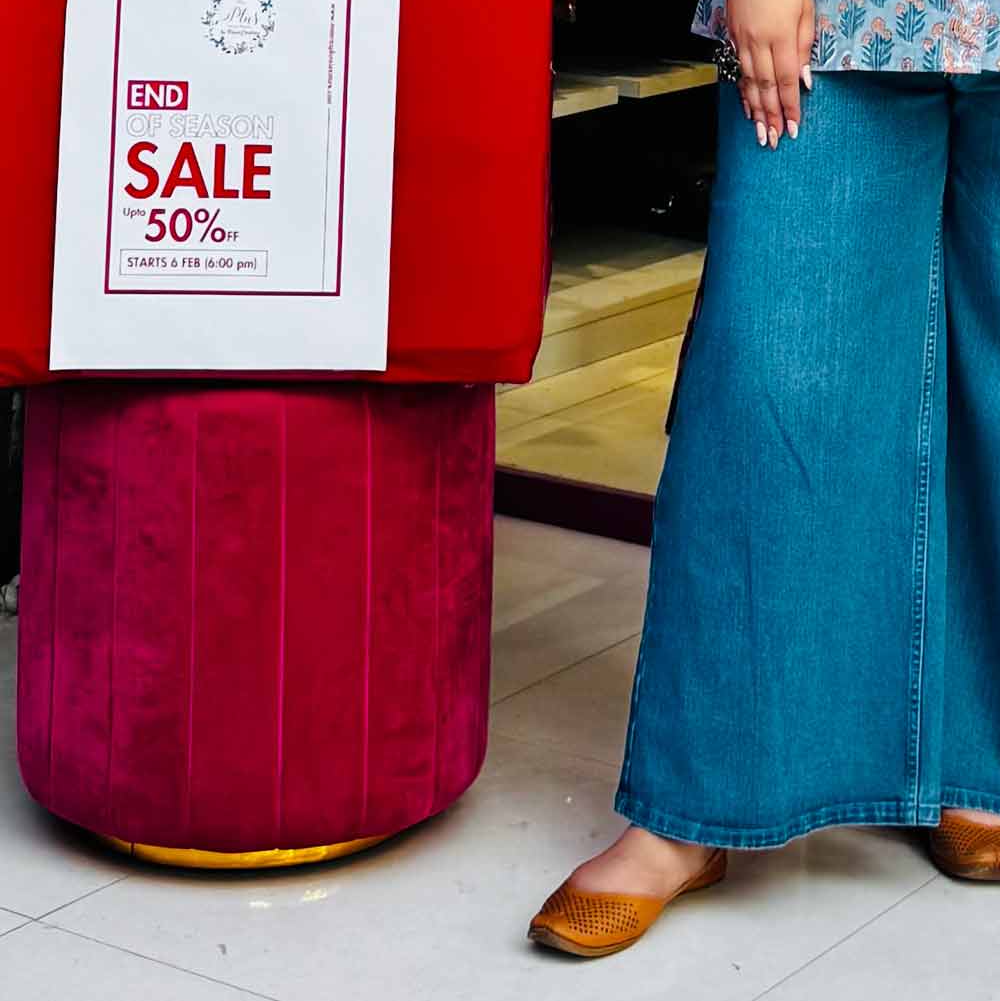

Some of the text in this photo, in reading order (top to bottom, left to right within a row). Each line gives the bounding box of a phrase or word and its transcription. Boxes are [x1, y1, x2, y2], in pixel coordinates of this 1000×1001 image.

[130, 83, 184, 107] END
[127, 113, 275, 139] OF SEASON
[124, 141, 273, 199] SALE
[123, 207, 146, 219] Upto
[127, 257, 257, 271] STARTS 6 FEB (6:00 pm)
